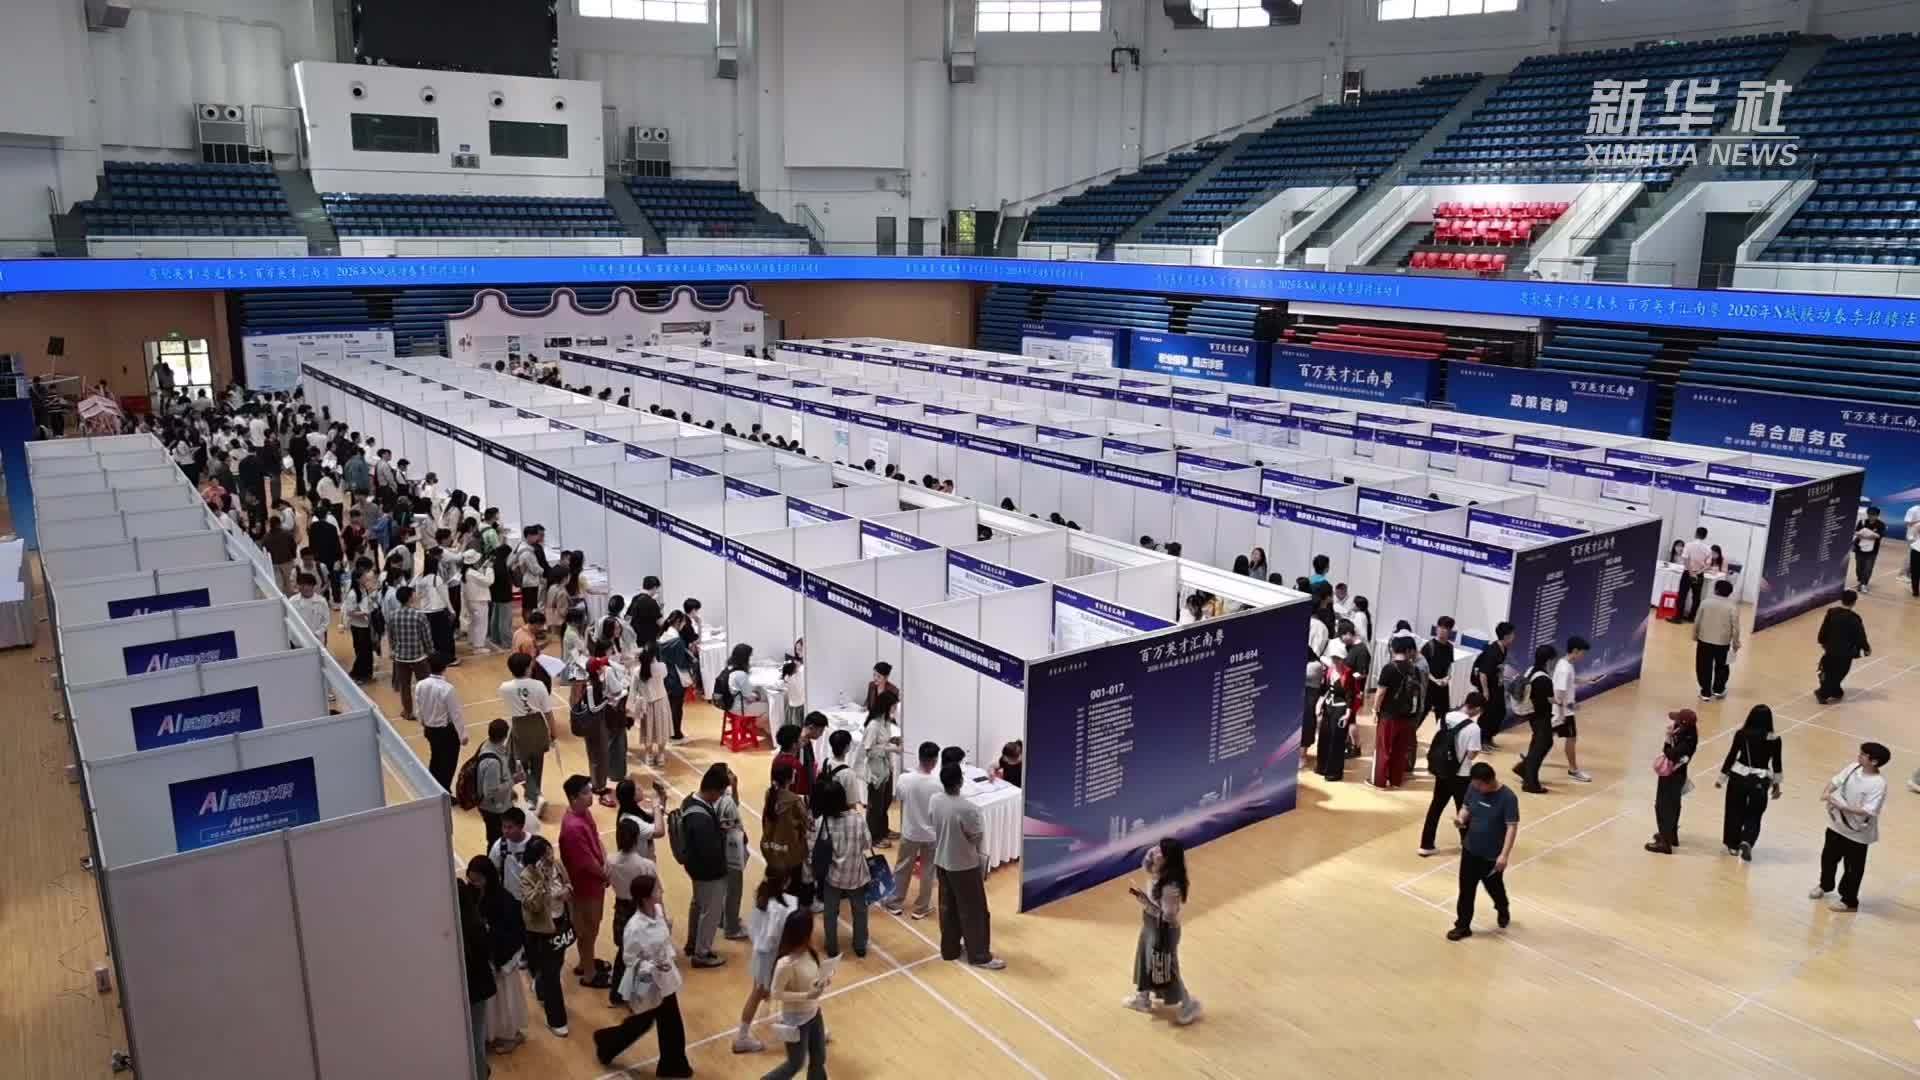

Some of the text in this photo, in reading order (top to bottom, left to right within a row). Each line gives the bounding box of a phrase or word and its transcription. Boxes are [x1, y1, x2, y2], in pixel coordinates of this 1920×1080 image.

[1298, 363, 1393, 389] 百万英才汇南粤
[1569, 381, 1635, 396] 百万英才汇南粤
[1510, 394, 1569, 413] 政策咨询
[1840, 410, 1920, 428] 百万英才汇南
[1749, 423, 1848, 449] 综合服务区
[1139, 628, 1225, 663] 百万英才汇南粤
[1090, 682, 1125, 700] 001-017
